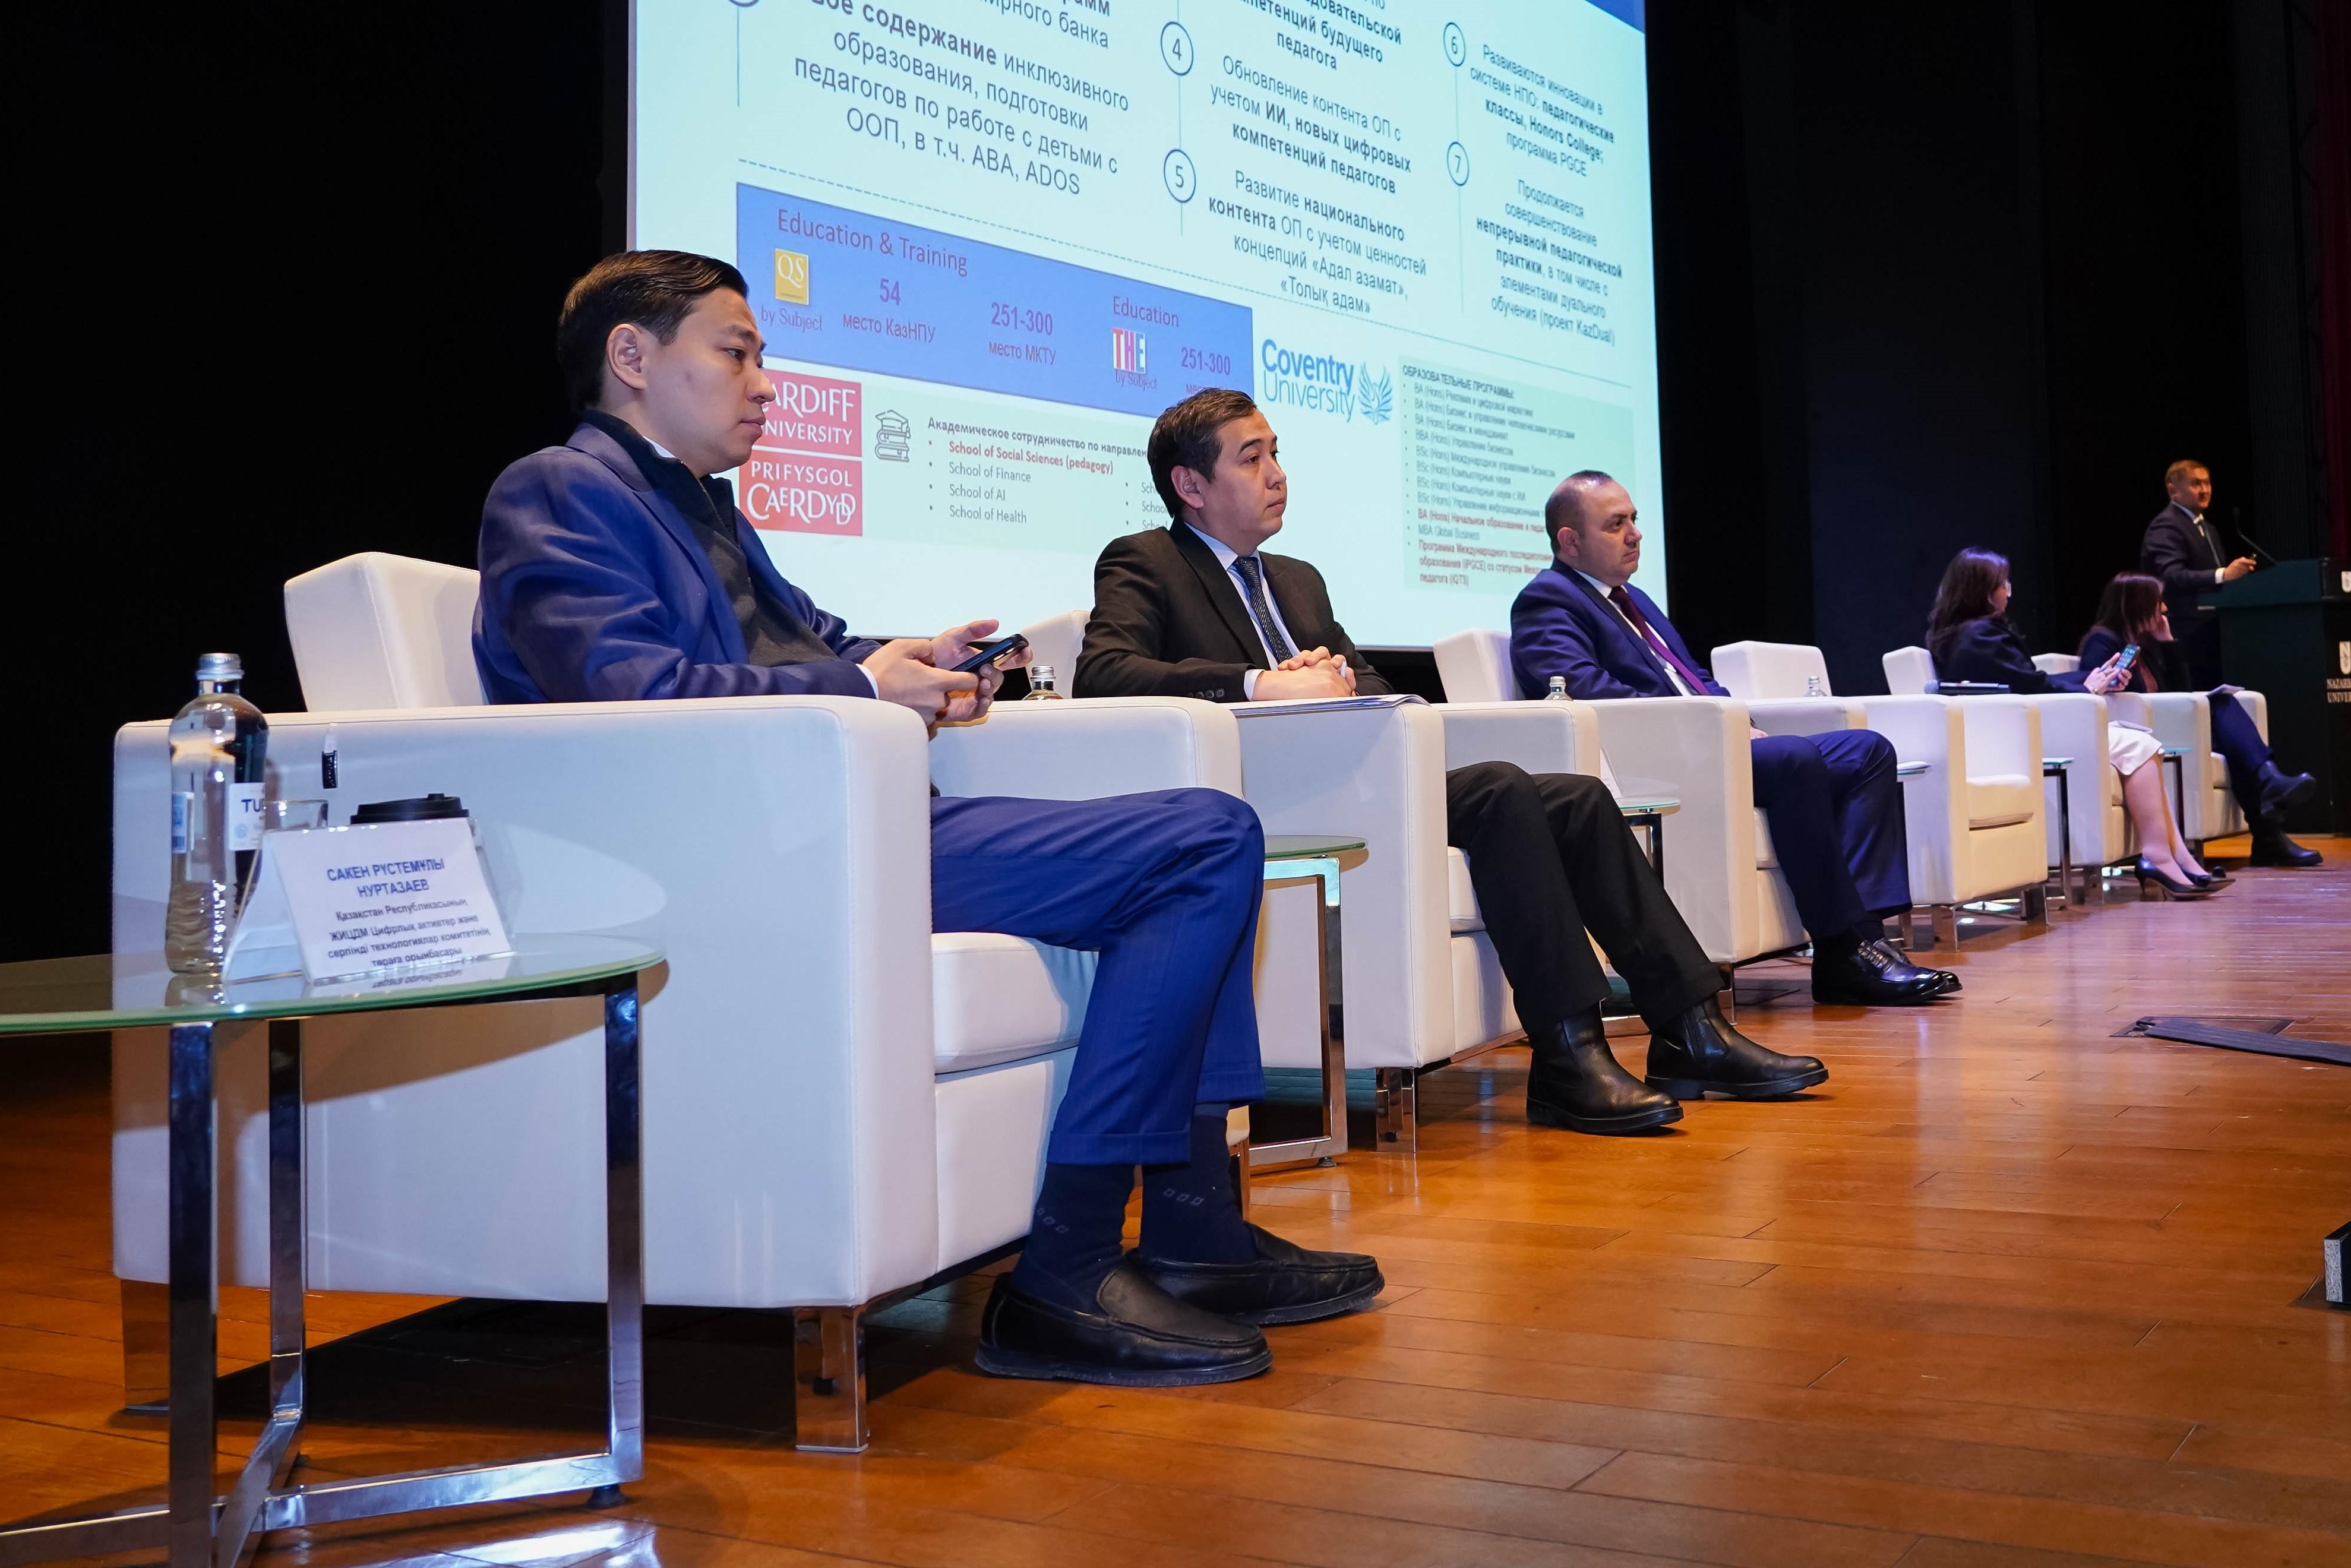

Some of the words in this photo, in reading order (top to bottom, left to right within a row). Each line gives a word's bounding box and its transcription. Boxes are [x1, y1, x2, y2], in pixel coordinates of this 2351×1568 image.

[1059, 12, 1108, 48] банка
[1322, 21, 1383, 63] будущего
[1451, 36, 1458, 55] 6
[862, 4, 997, 65] содержание
[1004, 53, 1129, 111] инклюзивного
[1172, 38, 1183, 61] 4
[1277, 31, 1336, 70] педагога
[834, 32, 978, 99] образования,
[987, 83, 1088, 132] подготовки
[1483, 44, 1545, 88] Развиваются
[1548, 79, 1595, 112] инновации
[1598, 103, 1603, 115] в
[795, 58, 906, 109] педагогов
[915, 96, 938, 118] по
[947, 106, 1015, 142] работе
[1023, 131, 1032, 147] с
[1038, 135, 1102, 169] детьми
[1108, 157, 1117, 173] с
[1223, 56, 1308, 105] Обновление
[1313, 94, 1368, 129] контента
[1372, 116, 1391, 138] ОП
[1395, 126, 1401, 141] с
[1470, 67, 1511, 96] системе
[1514, 83, 1540, 109] НПО:
[1543, 100, 1614, 143] педагогические
[1211, 84, 1260, 116] учетом
[1266, 101, 1290, 131] ИИ,
[1295, 116, 1339, 146] новых
[1344, 134, 1411, 173] цифровых
[1486, 99, 1527, 131] классы,
[1530, 115, 1563, 144] Honors
[847, 108, 905, 148] ООП,
[915, 132, 925, 150] в
[934, 137, 965, 163] т.ч.
[1026, 160, 1080, 194] ADOS
[1233, 123, 1326, 169] компетенций
[1331, 159, 1395, 194] педагогов
[1455, 155, 1461, 173] 7
[1506, 132, 1557, 164] программа
[1560, 152, 1587, 177] PGCE
[1175, 165, 1184, 188] 5
[1235, 170, 1300, 208] Развитие
[1304, 197, 1405, 241] национального
[1518, 179, 1584, 219] Продолжается
[778, 208, 873, 252] Education
[879, 232, 893, 256] &
[899, 237, 968, 277] Training
[1209, 197, 1276, 231] контента
[1281, 216, 1302, 240] ОП
[1307, 225, 1313, 242] с
[1318, 230, 1361, 257] учетом
[1366, 244, 1427, 276] ценностей
[1505, 203, 1597, 247] совершенствование
[1477, 217, 1547, 252] непрерывной
[1550, 242, 1622, 278] педагогической
[778, 254, 804, 289] QS
[1234, 235, 1307, 270] концепций
[1312, 257, 1352, 283] «Адал
[1356, 274, 1408, 301] азамат»,
[1548, 267, 1554, 279] в
[1556, 268, 1573, 285] том
[1575, 276, 1601, 293] числе
[1603, 284, 1609, 296] с
[879, 277, 901, 306] 54
[1281, 276, 1329, 306] «Толық
[1332, 290, 1371, 314] адам»
[1500, 276, 1558, 304] элементами
[1560, 295, 1606, 319] дуального
[761, 305, 775, 327] by
[780, 308, 823, 333] Subject
[843, 314, 882, 334] место
[886, 317, 936, 343] КазНПУ
[991, 302, 1054, 336] 251-300
[1113, 295, 1179, 328] Education
[1492, 296, 1537, 321] обучения
[1540, 308, 1574, 331] (проект
[988, 340, 1022, 361] место
[1026, 343, 1056, 365] МКТУ
[1112, 328, 1145, 373] THE
[1181, 347, 1231, 375] 251-300
[1262, 339, 1354, 396] Coventry
[1115, 369, 1125, 388] by
[1128, 372, 1158, 391] Subject
[1263, 369, 1355, 423] University
[762, 381, 856, 422] ARDIFF
[762, 420, 853, 445] NIVERSITY
[928, 416, 1009, 440] Академическое
[1012, 431, 1085, 450] сотрудничество
[1088, 442, 1098, 451] по
[1101, 444, 1148, 457] направлен
[751, 460, 852, 487] PRIFYSGOL
[949, 441, 981, 456] School
[984, 445, 994, 457] of
[997, 447, 1023, 461] Social
[1026, 451, 1063, 466] Sciences
[1066, 454, 1113, 475] (pedagogy)
[949, 461, 981, 477] School
[984, 466, 994, 478] of
[996, 467, 1031, 482] Finance
[949, 483, 981, 499] School
[984, 487, 994, 500] of
[996, 489, 1006, 501] AI
[949, 504, 981, 520] School
[984, 508, 994, 520] of
[997, 509, 1027, 524] Health
[327, 865, 371, 881] САКЕН
[357, 878, 429, 898] НУРТАЗАЕВ
[336, 908, 383, 921] Қазақстан
[418, 918, 457, 931] активтер
[371, 935, 440, 953] технологиялар
